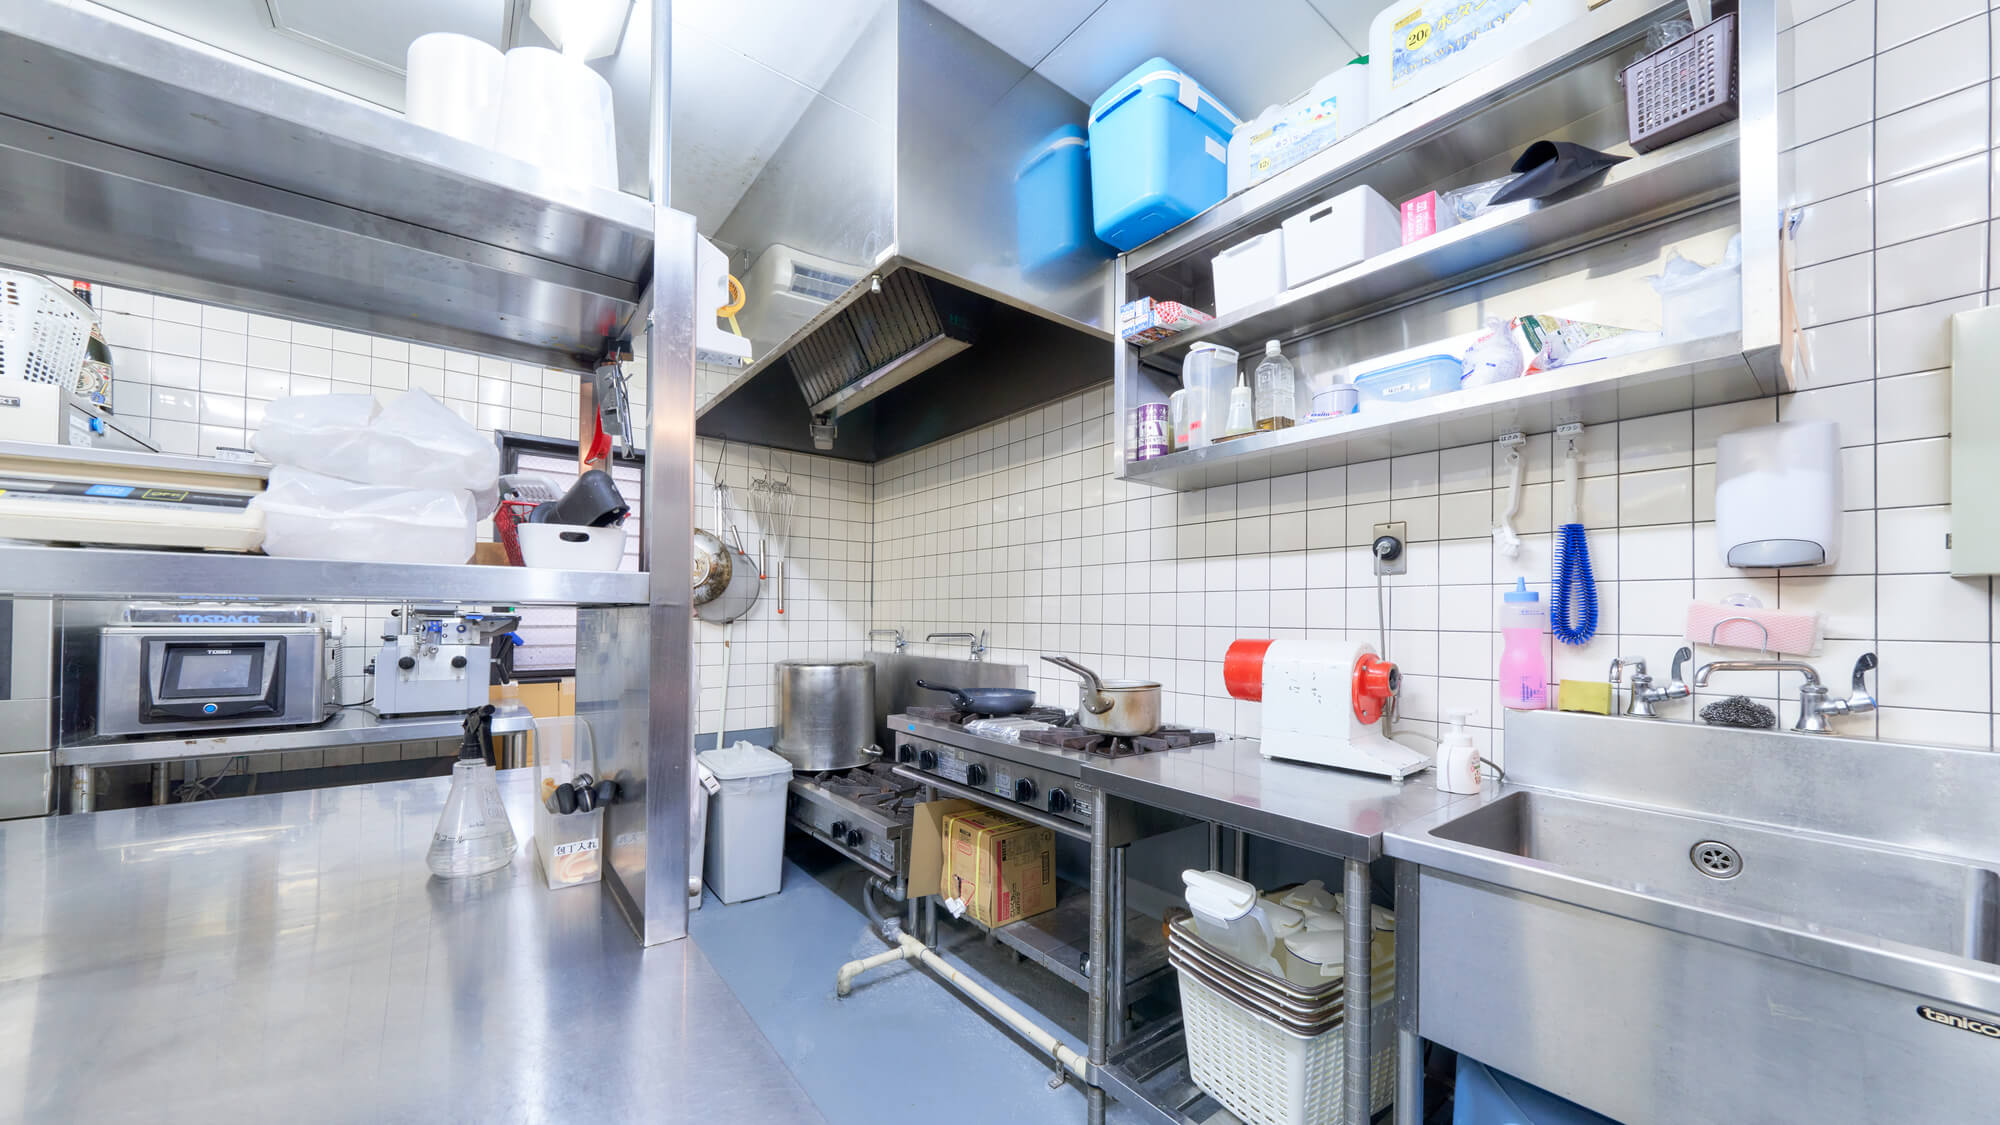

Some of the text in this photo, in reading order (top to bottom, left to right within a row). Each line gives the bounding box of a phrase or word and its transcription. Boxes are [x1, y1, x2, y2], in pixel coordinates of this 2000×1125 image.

[178, 614, 260, 624] TOSPACK
[556, 841, 597, 855] 包丁入れ
[1923, 1007, 2000, 1037] tanico
